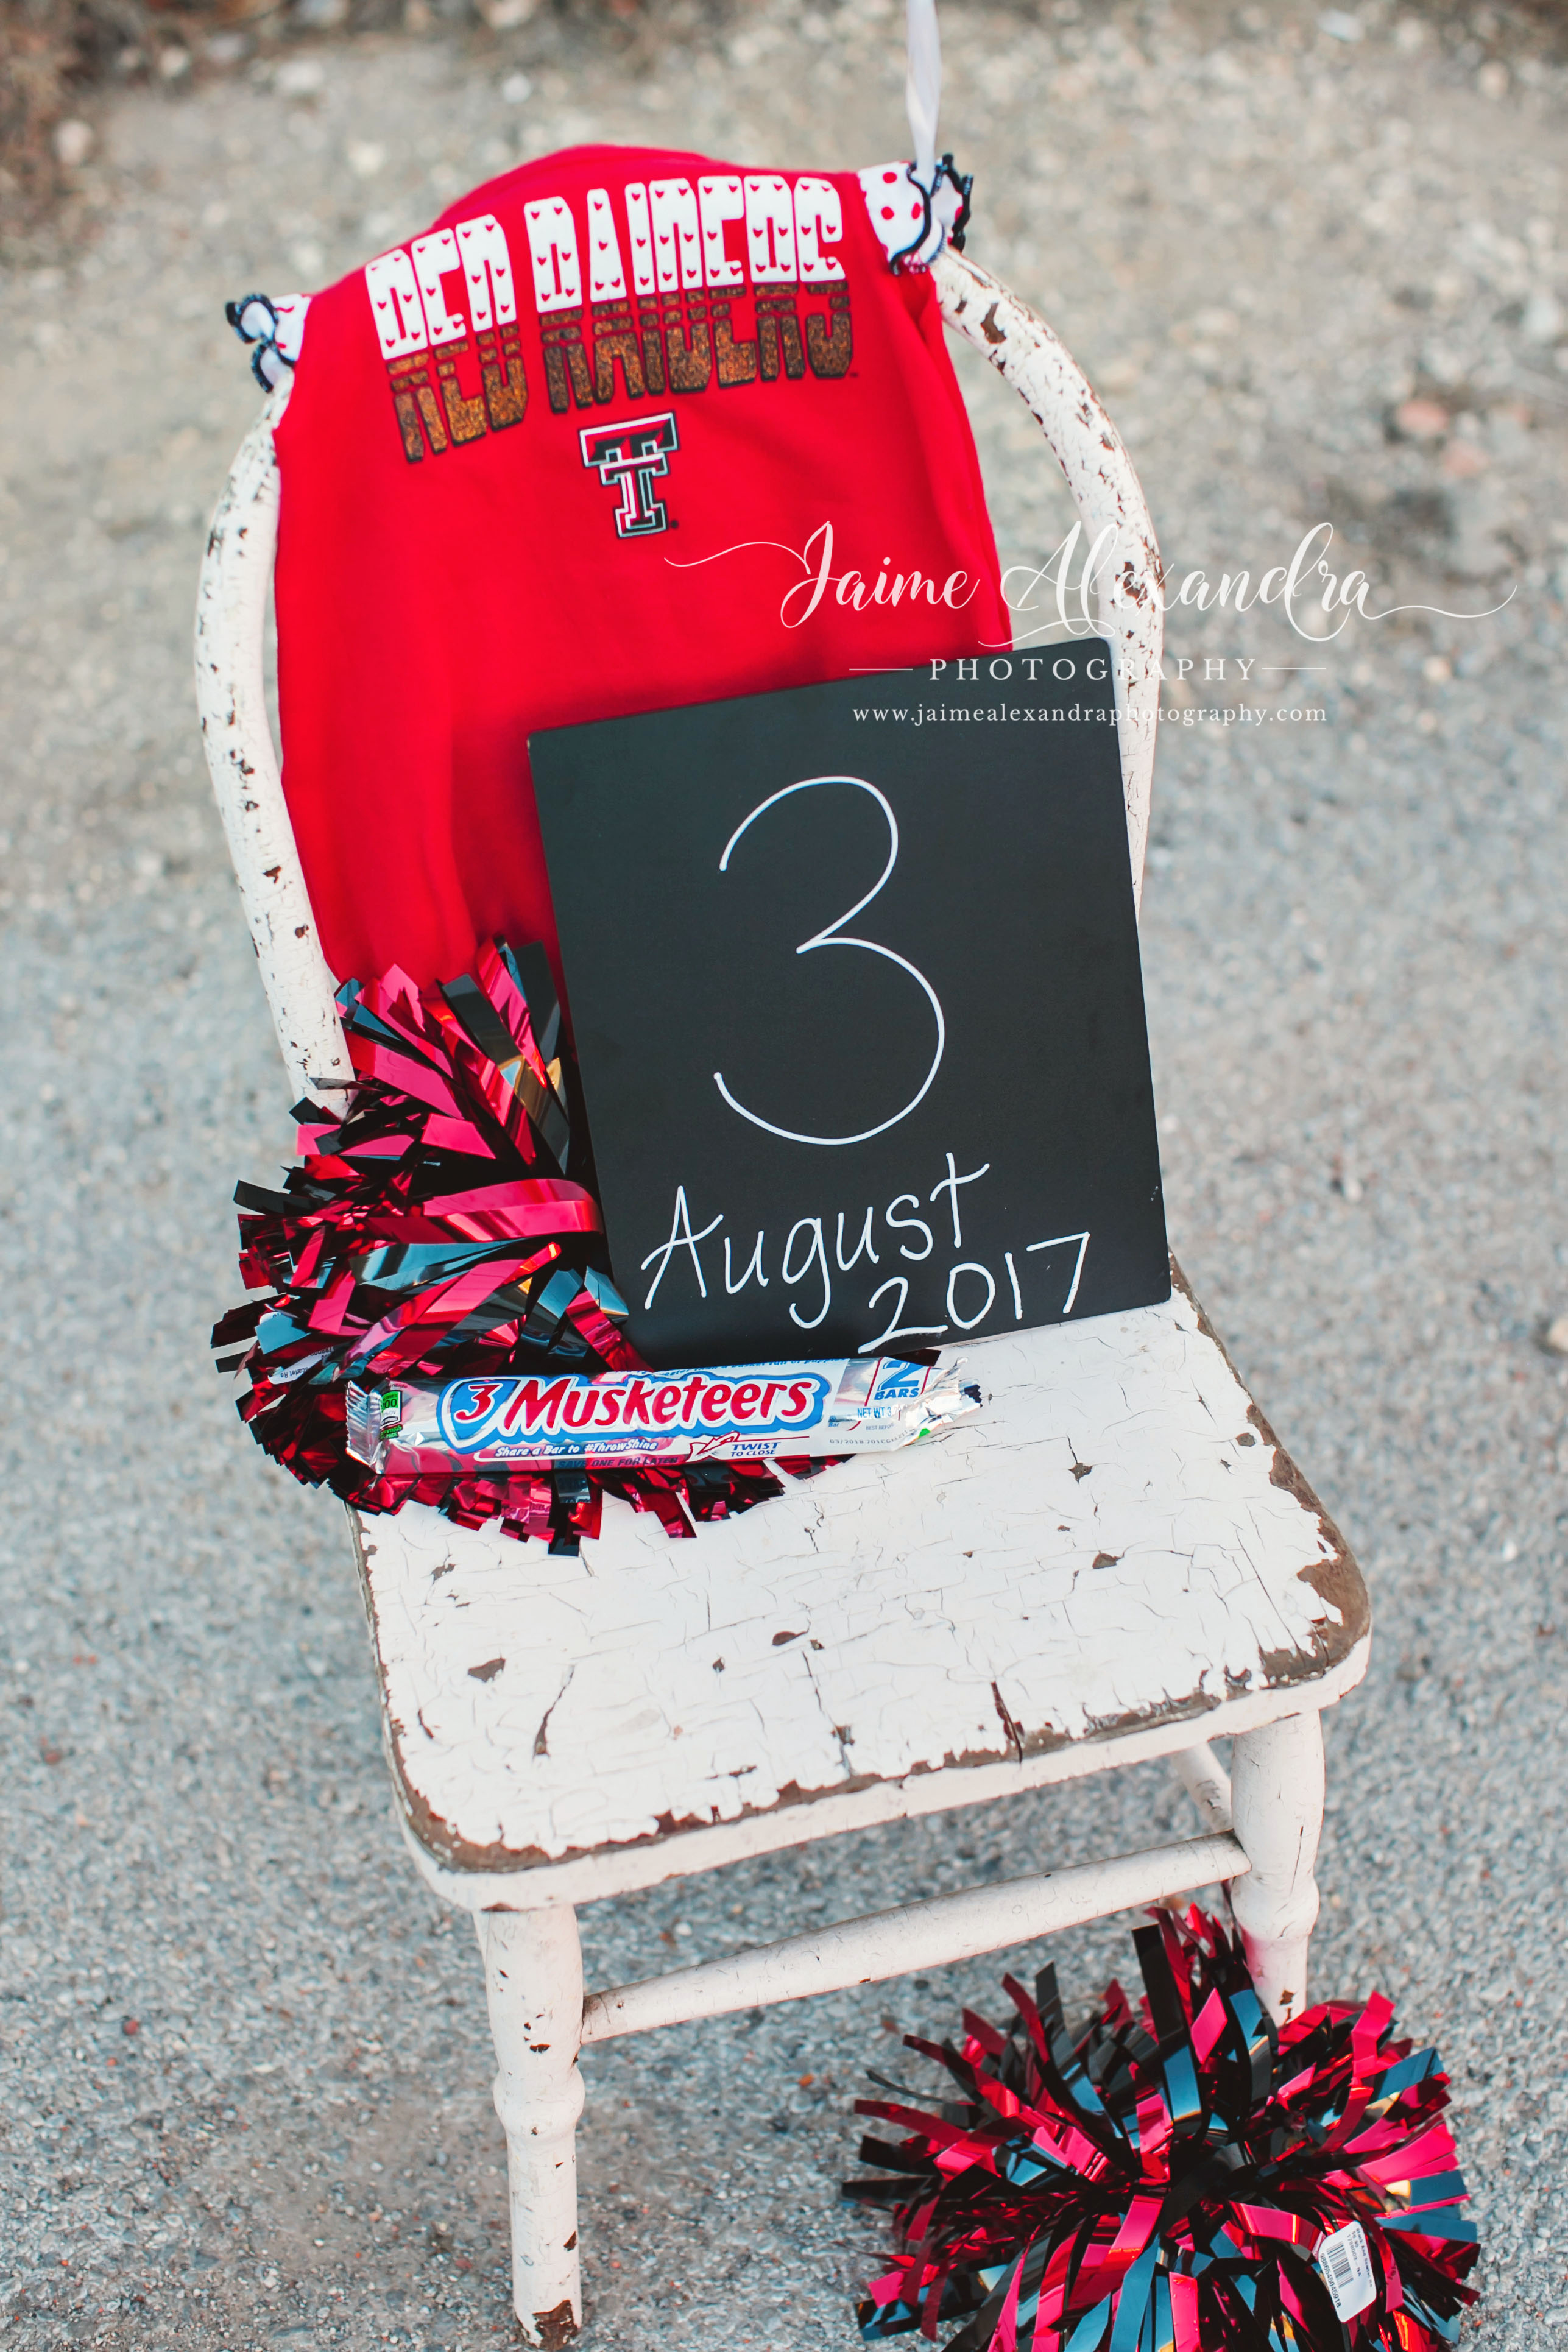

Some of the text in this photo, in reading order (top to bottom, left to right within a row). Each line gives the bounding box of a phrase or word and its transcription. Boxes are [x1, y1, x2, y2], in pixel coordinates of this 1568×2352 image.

[713, 774, 945, 1146] 3
[641, 1152, 991, 1329] August
[858, 1231, 1091, 1354] 2017
[879, 1360, 922, 1391] 2
[455, 1376, 814, 1431] 3 Musketeers
[874, 1387, 920, 1400] BARS
[857, 1407, 871, 1418] NET
[873, 1407, 886, 1418] WT
[495, 1439, 658, 1458] Share a Bar to #ThrowShine
[732, 1441, 782, 1451] TWIST
[591, 1459, 613, 1467] ONE
[618, 1457, 640, 1466] FOR
